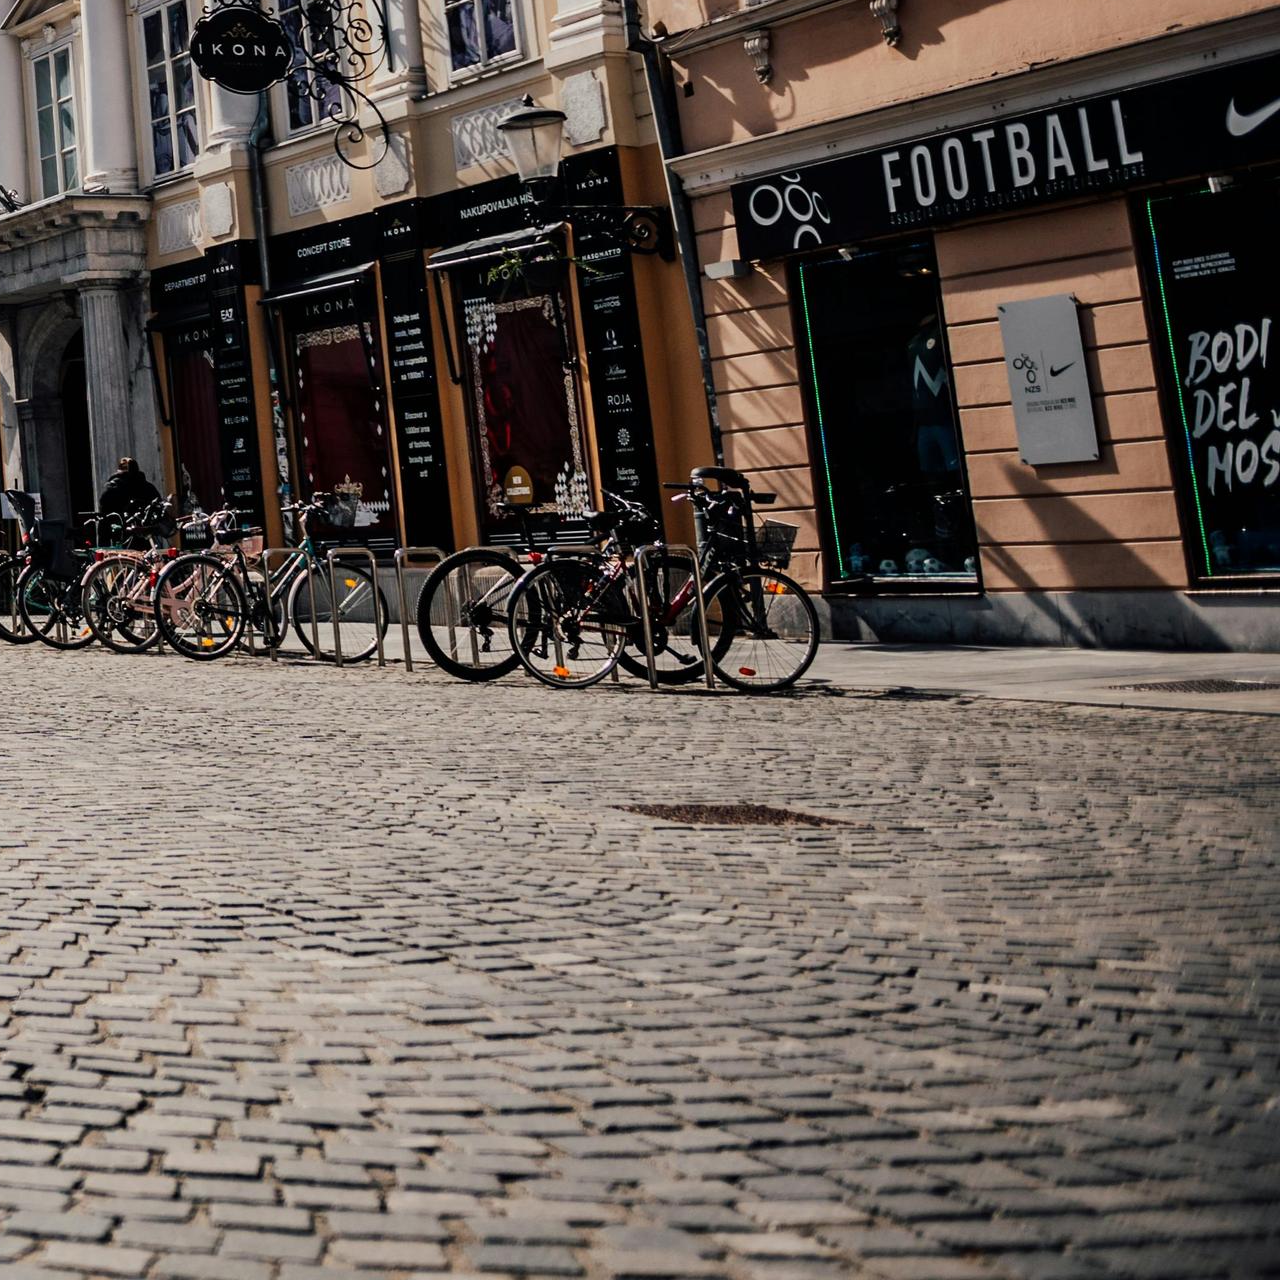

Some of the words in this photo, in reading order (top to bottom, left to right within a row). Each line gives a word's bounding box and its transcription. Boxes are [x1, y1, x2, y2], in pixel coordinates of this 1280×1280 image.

[198, 43, 287, 57] IKONA
[881, 98, 1144, 213] FOOTBALL
[576, 176, 610, 191] IKONA
[889, 202, 961, 224] ASSOCIATION
[984, 186, 1039, 208] SLOVENIA
[1047, 172, 1101, 195] OFFICIAL
[1108, 164, 1146, 185] STORE
[460, 197, 519, 219] NAKUPOVALNA
[384, 225, 412, 237] IKONA
[297, 242, 328, 258] CONCEPT
[329, 237, 352, 251] STORE
[212, 264, 235, 275] IKONA
[164, 275, 199, 292] DEPARTMENT
[305, 299, 355, 316] IKONA
[1184, 317, 1272, 387] BODI
[607, 394, 632, 406] ROJA
[1192, 377, 1260, 438] DEL
